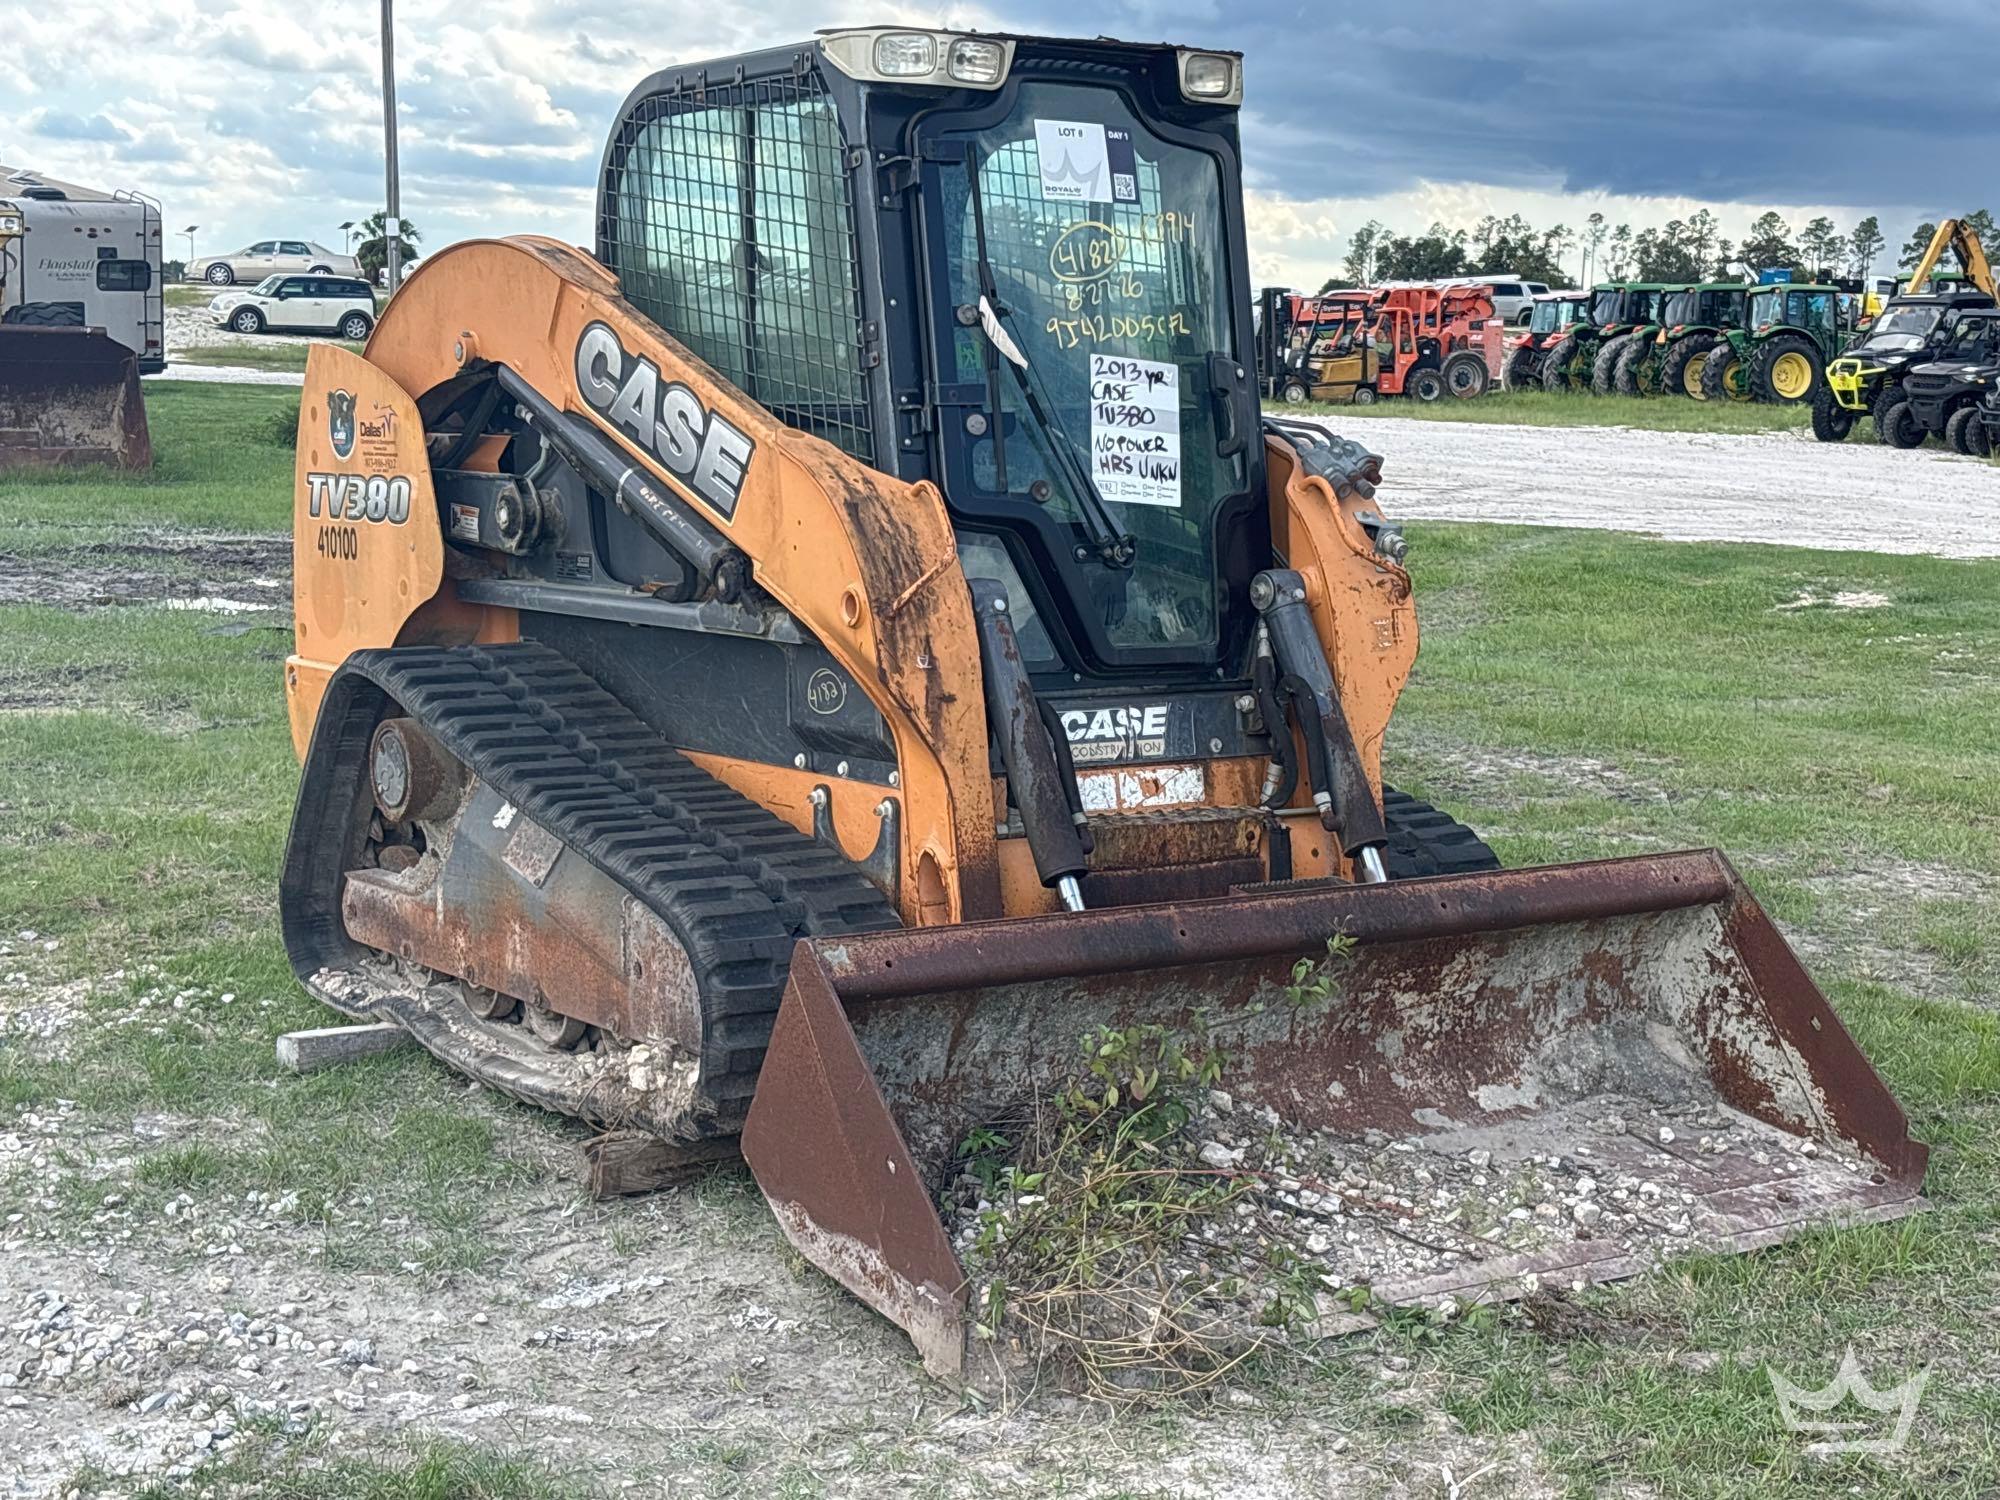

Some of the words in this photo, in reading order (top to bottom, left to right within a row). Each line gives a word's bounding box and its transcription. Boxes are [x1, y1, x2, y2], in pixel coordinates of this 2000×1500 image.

[1058, 127, 1076, 138] LOT
[1108, 130, 1123, 140] DAY
[1123, 132, 1129, 141] 1
[38, 259, 95, 270] Flagstaff
[1058, 239, 1112, 273] 4182
[1094, 357, 1142, 382] 2013
[1091, 381, 1139, 401] CASE
[576, 323, 754, 519] CASE
[1100, 454, 1133, 475] HRS
[307, 472, 412, 525] TV380
[317, 526, 358, 560] 410100
[1061, 706, 1168, 741] CASE
